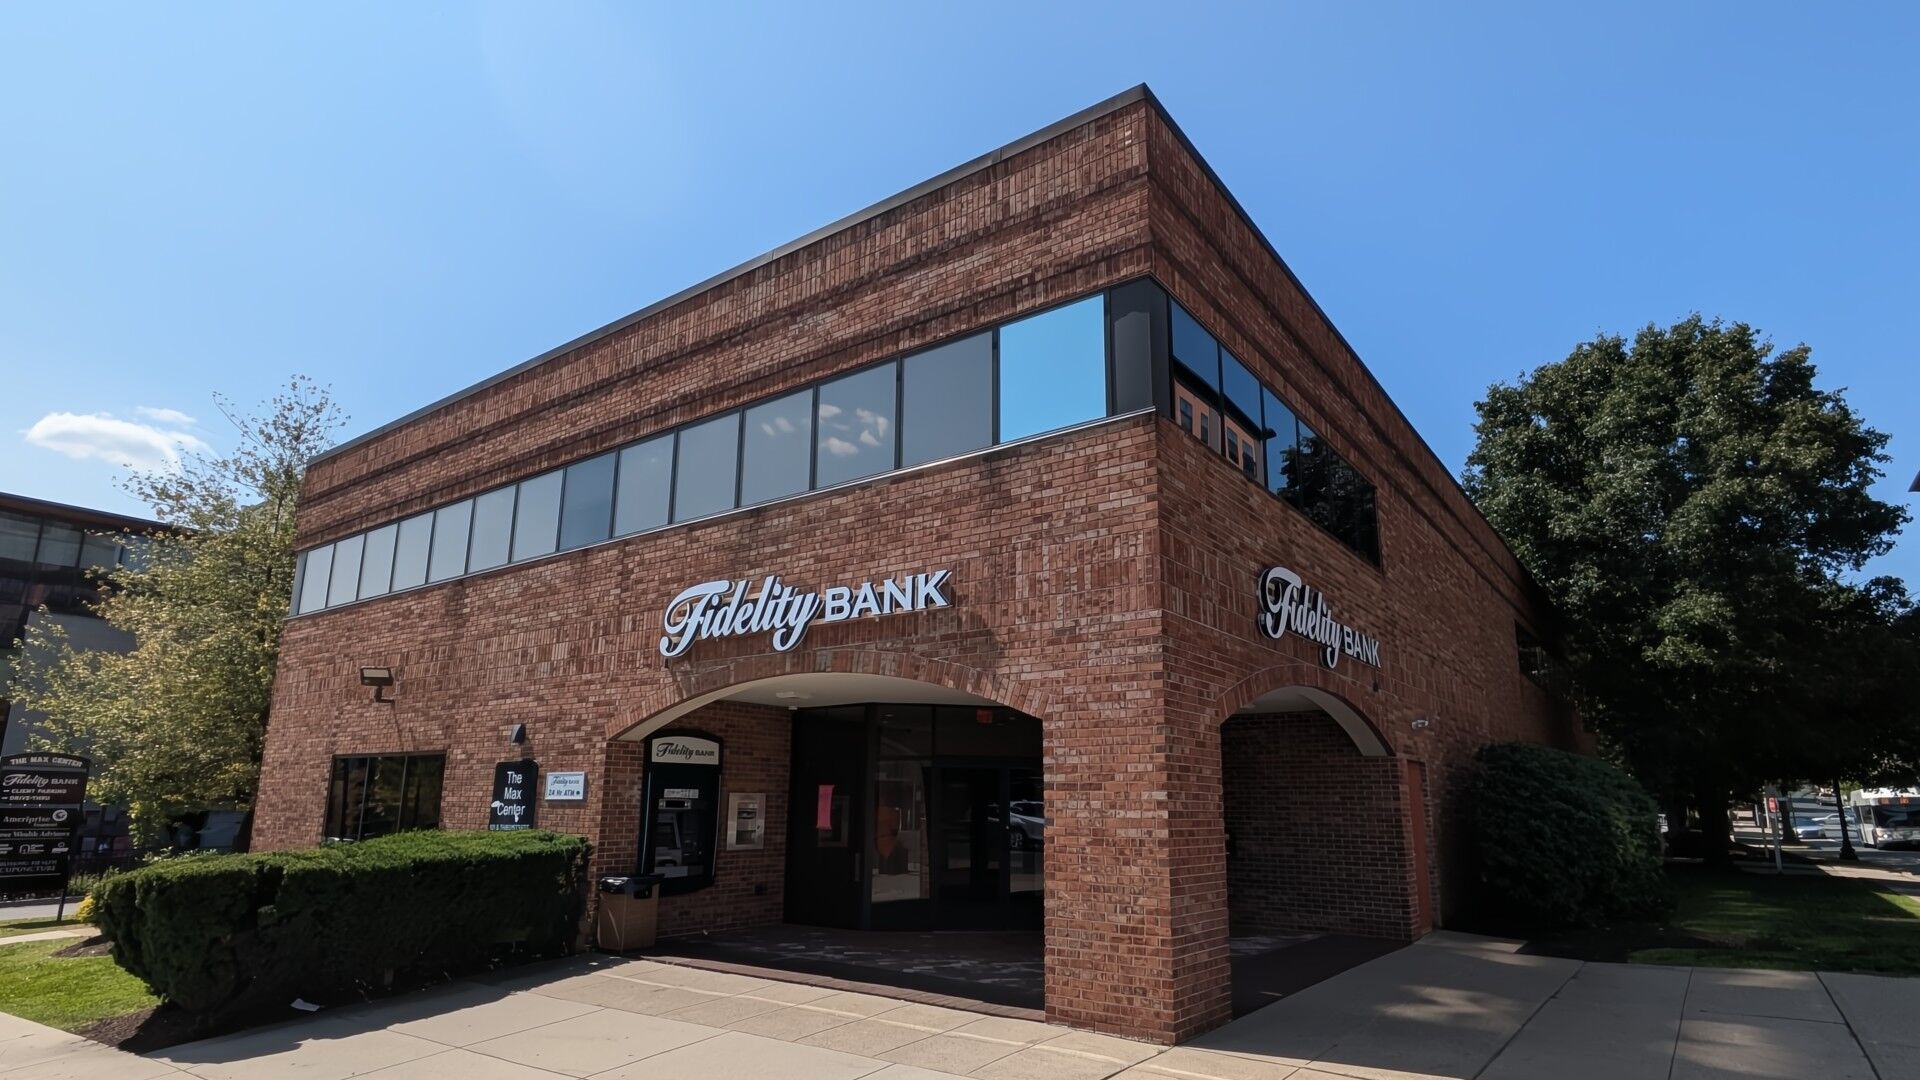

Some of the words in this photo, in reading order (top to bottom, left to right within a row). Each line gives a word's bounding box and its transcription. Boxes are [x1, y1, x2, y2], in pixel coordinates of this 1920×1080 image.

[660, 575, 824, 657] Fidelity
[824, 569, 952, 623] BANK
[1258, 566, 1343, 669] Fidelity
[1343, 624, 1382, 669] BANK
[656, 742, 694, 759] Fidelity
[10, 757, 27, 765] THE
[52, 757, 83, 767] CENTER
[2, 774, 49, 787] Fidelity
[507, 771, 523, 784] The
[504, 787, 522, 800] Max
[497, 802, 525, 816] Center
